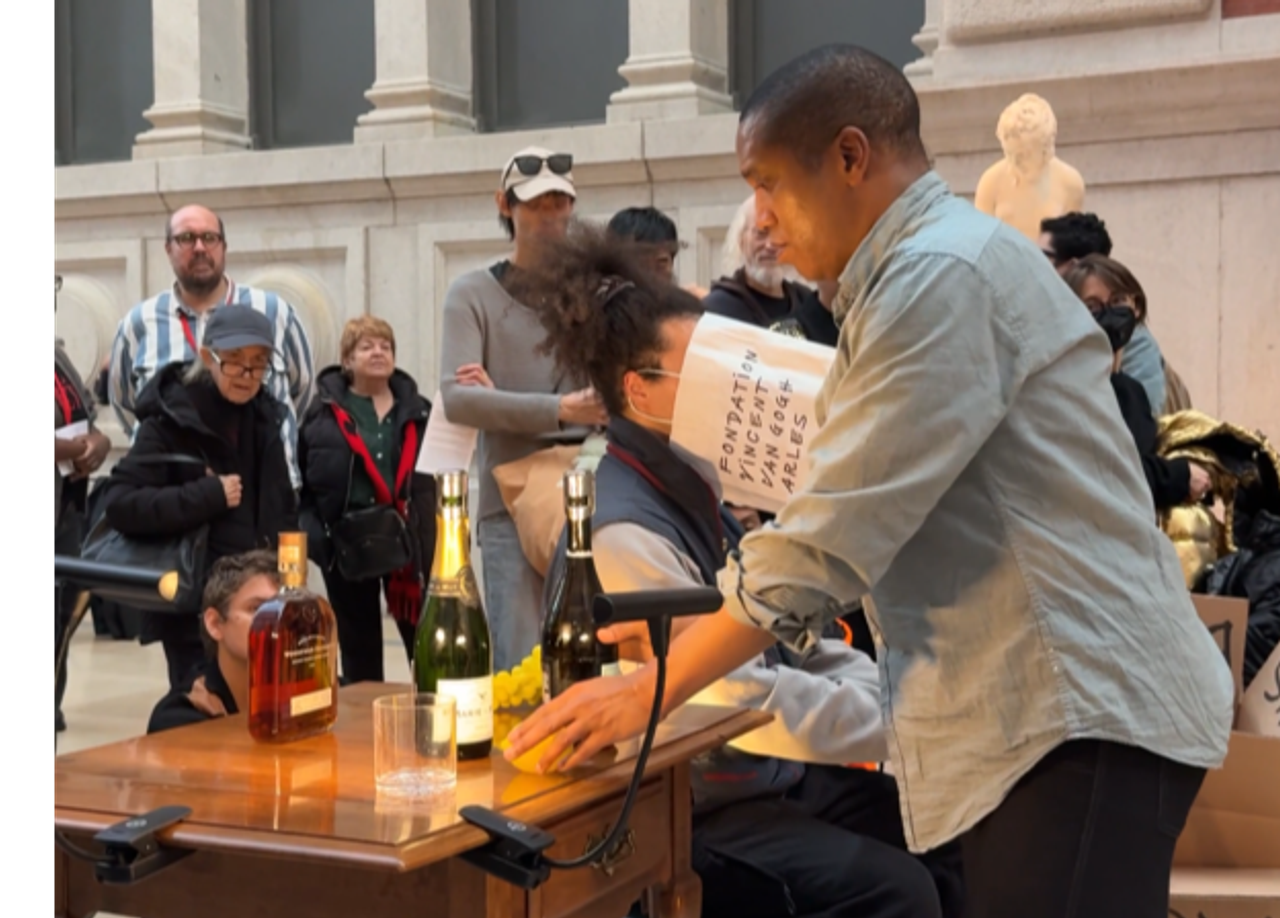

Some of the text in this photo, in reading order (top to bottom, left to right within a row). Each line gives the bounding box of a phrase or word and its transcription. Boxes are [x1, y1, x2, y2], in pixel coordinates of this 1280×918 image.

[760, 379, 794, 489] VAN GOGH
[781, 412, 808, 495] ARLES
